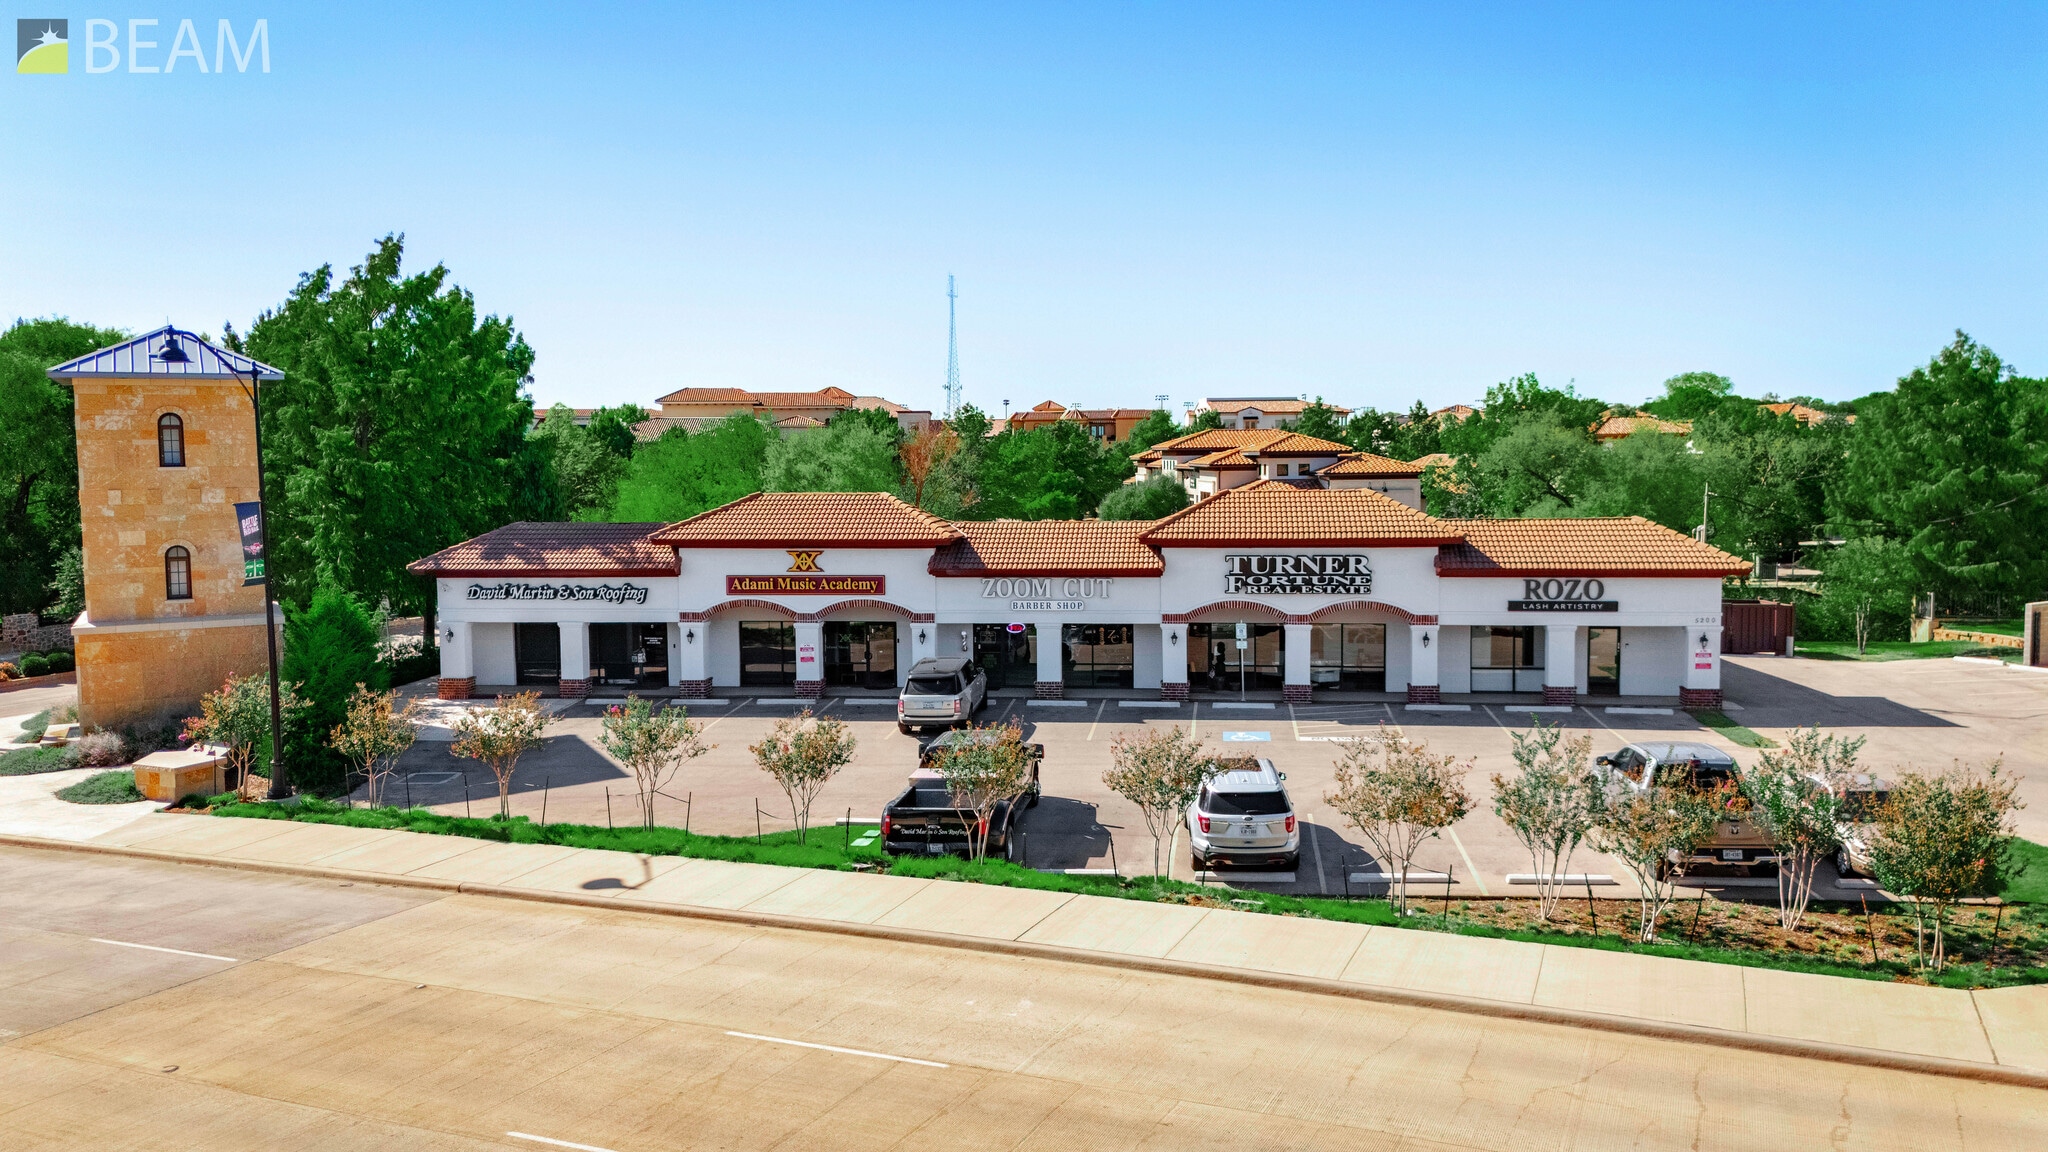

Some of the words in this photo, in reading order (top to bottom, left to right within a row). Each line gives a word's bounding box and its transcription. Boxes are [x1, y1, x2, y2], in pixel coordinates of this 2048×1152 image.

[1225, 555, 1372, 575] TURNER
[467, 584, 508, 599] David
[510, 584, 555, 600] Martin
[558, 586, 570, 600] &
[570, 585, 594, 600] Son
[597, 584, 647, 604] Roofing
[731, 578, 774, 590] Adami
[778, 578, 816, 590] Music
[819, 578, 878, 593] Academy
[981, 578, 1052, 599] ZOOM
[1063, 578, 1114, 599] CUT
[1225, 575, 1371, 594] FORTUNE
[1246, 586, 1297, 594] REAL
[1301, 586, 1371, 594] ESTATE
[1523, 579, 1604, 600] ROZO
[1012, 602, 1052, 610] BARBER
[1056, 602, 1083, 610] SHOP
